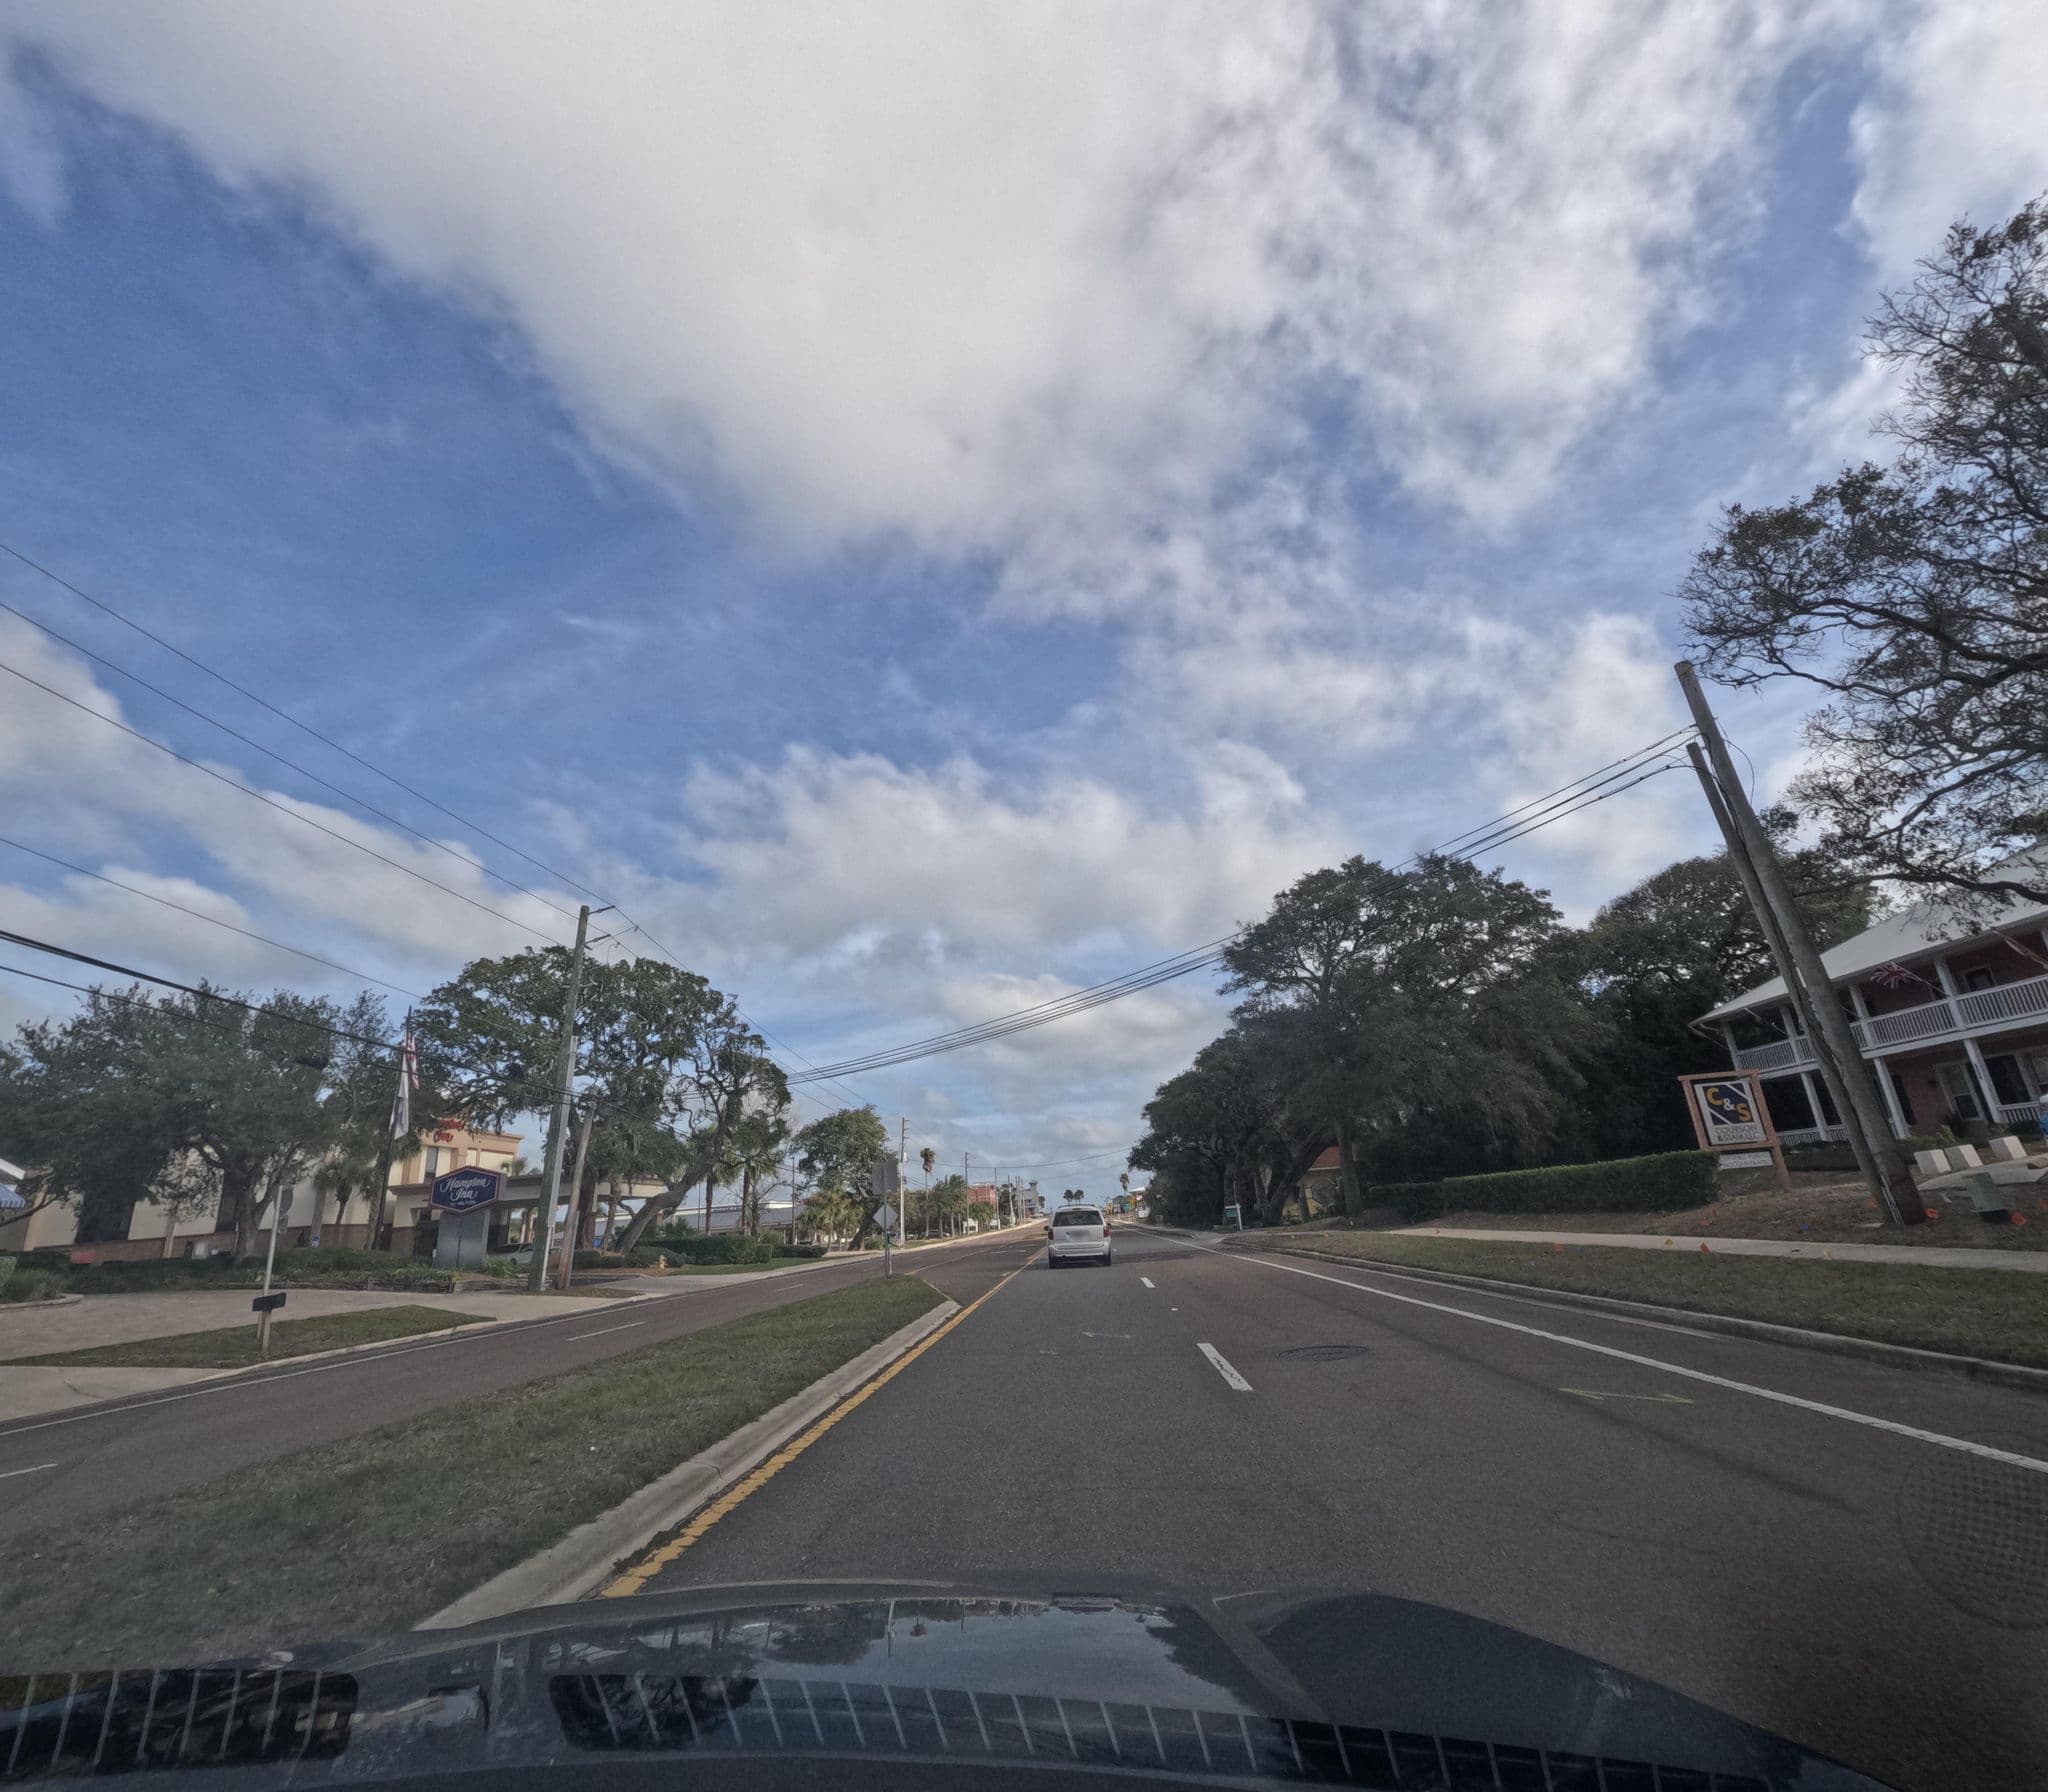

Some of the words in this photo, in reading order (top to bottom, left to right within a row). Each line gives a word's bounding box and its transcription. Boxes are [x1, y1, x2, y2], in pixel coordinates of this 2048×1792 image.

[1715, 1125, 1758, 1135] COURSON
[440, 1177, 490, 1192] Hampton
[450, 1187, 478, 1201] Inn
